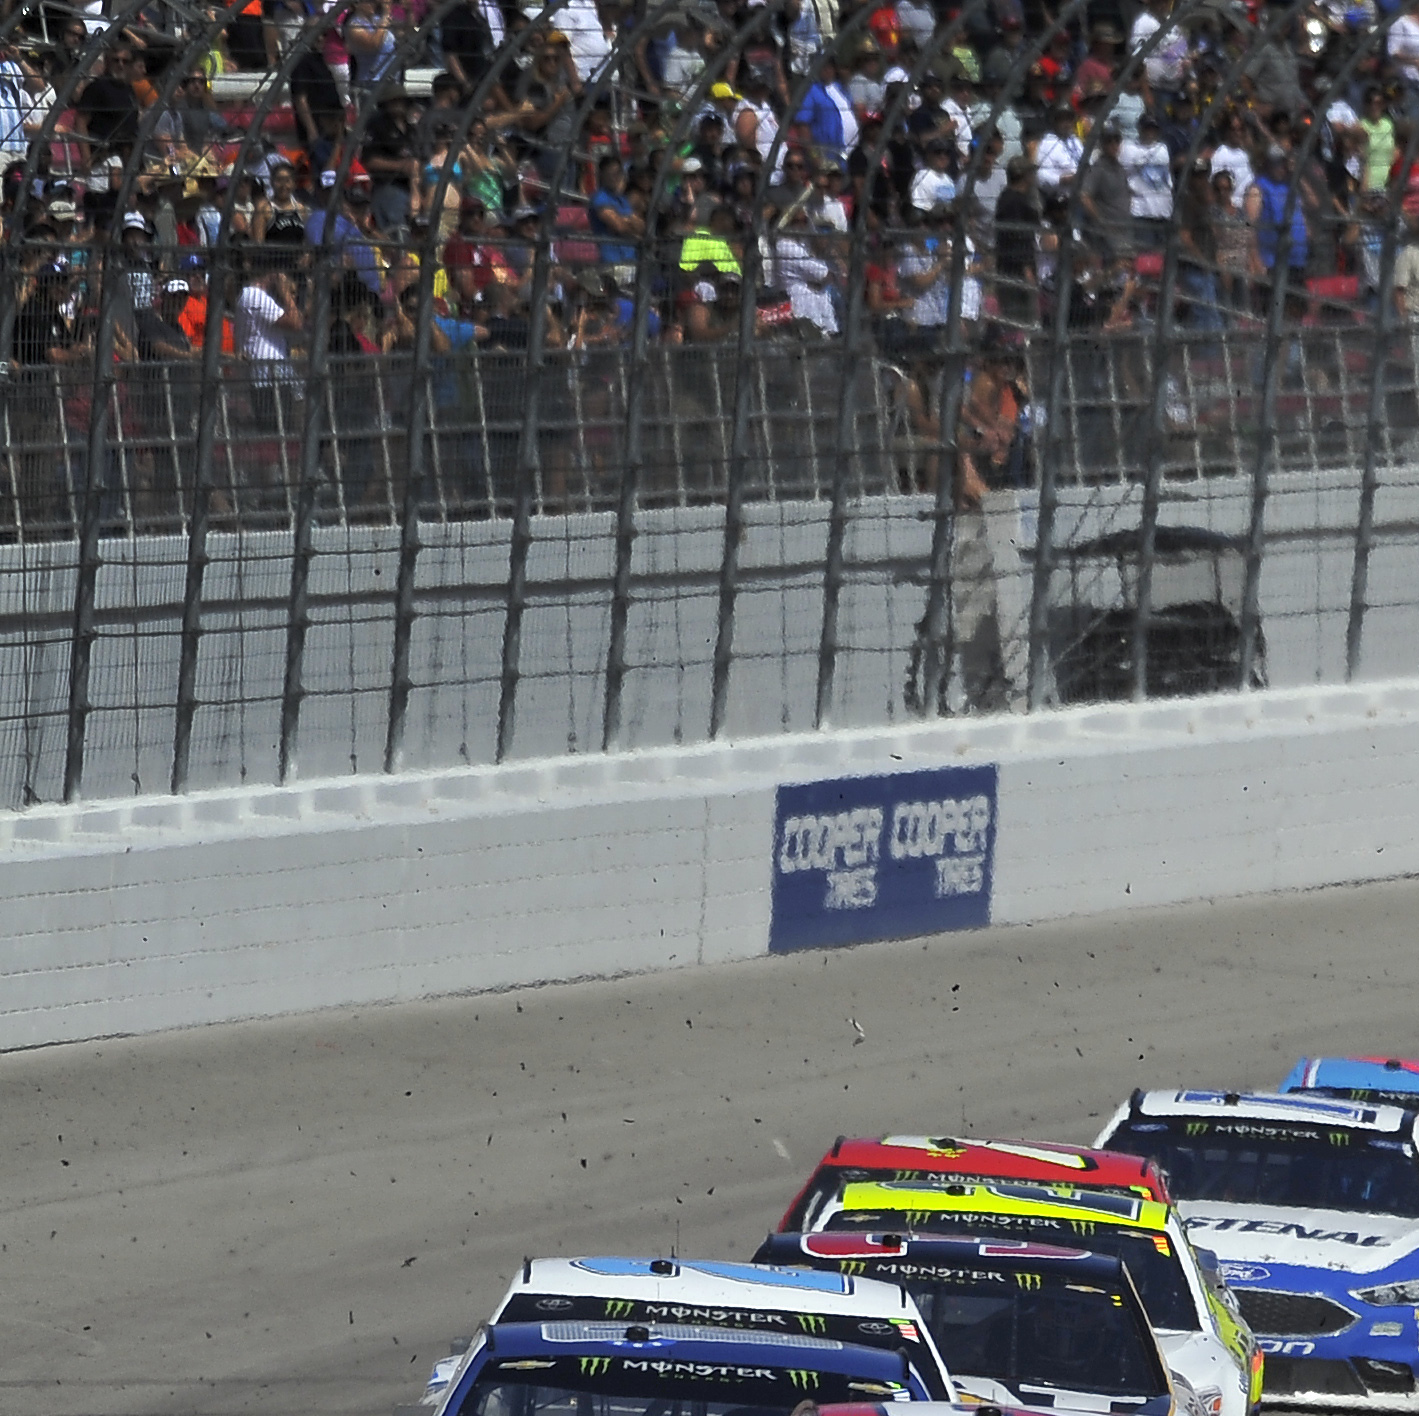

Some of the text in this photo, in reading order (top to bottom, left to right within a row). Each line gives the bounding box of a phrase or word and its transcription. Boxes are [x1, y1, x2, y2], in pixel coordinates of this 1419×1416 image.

[890, 795, 989, 859] COOPER
[780, 806, 884, 874] COOPER
[1214, 1123, 1321, 1141] MONSTER
[940, 1211, 1061, 1230] MONSTER
[1183, 1216, 1395, 1248] STENAL
[876, 1263, 1006, 1283] MONSTER
[645, 1304, 787, 1326] MONSTER
[622, 1359, 779, 1382] MONSTER
